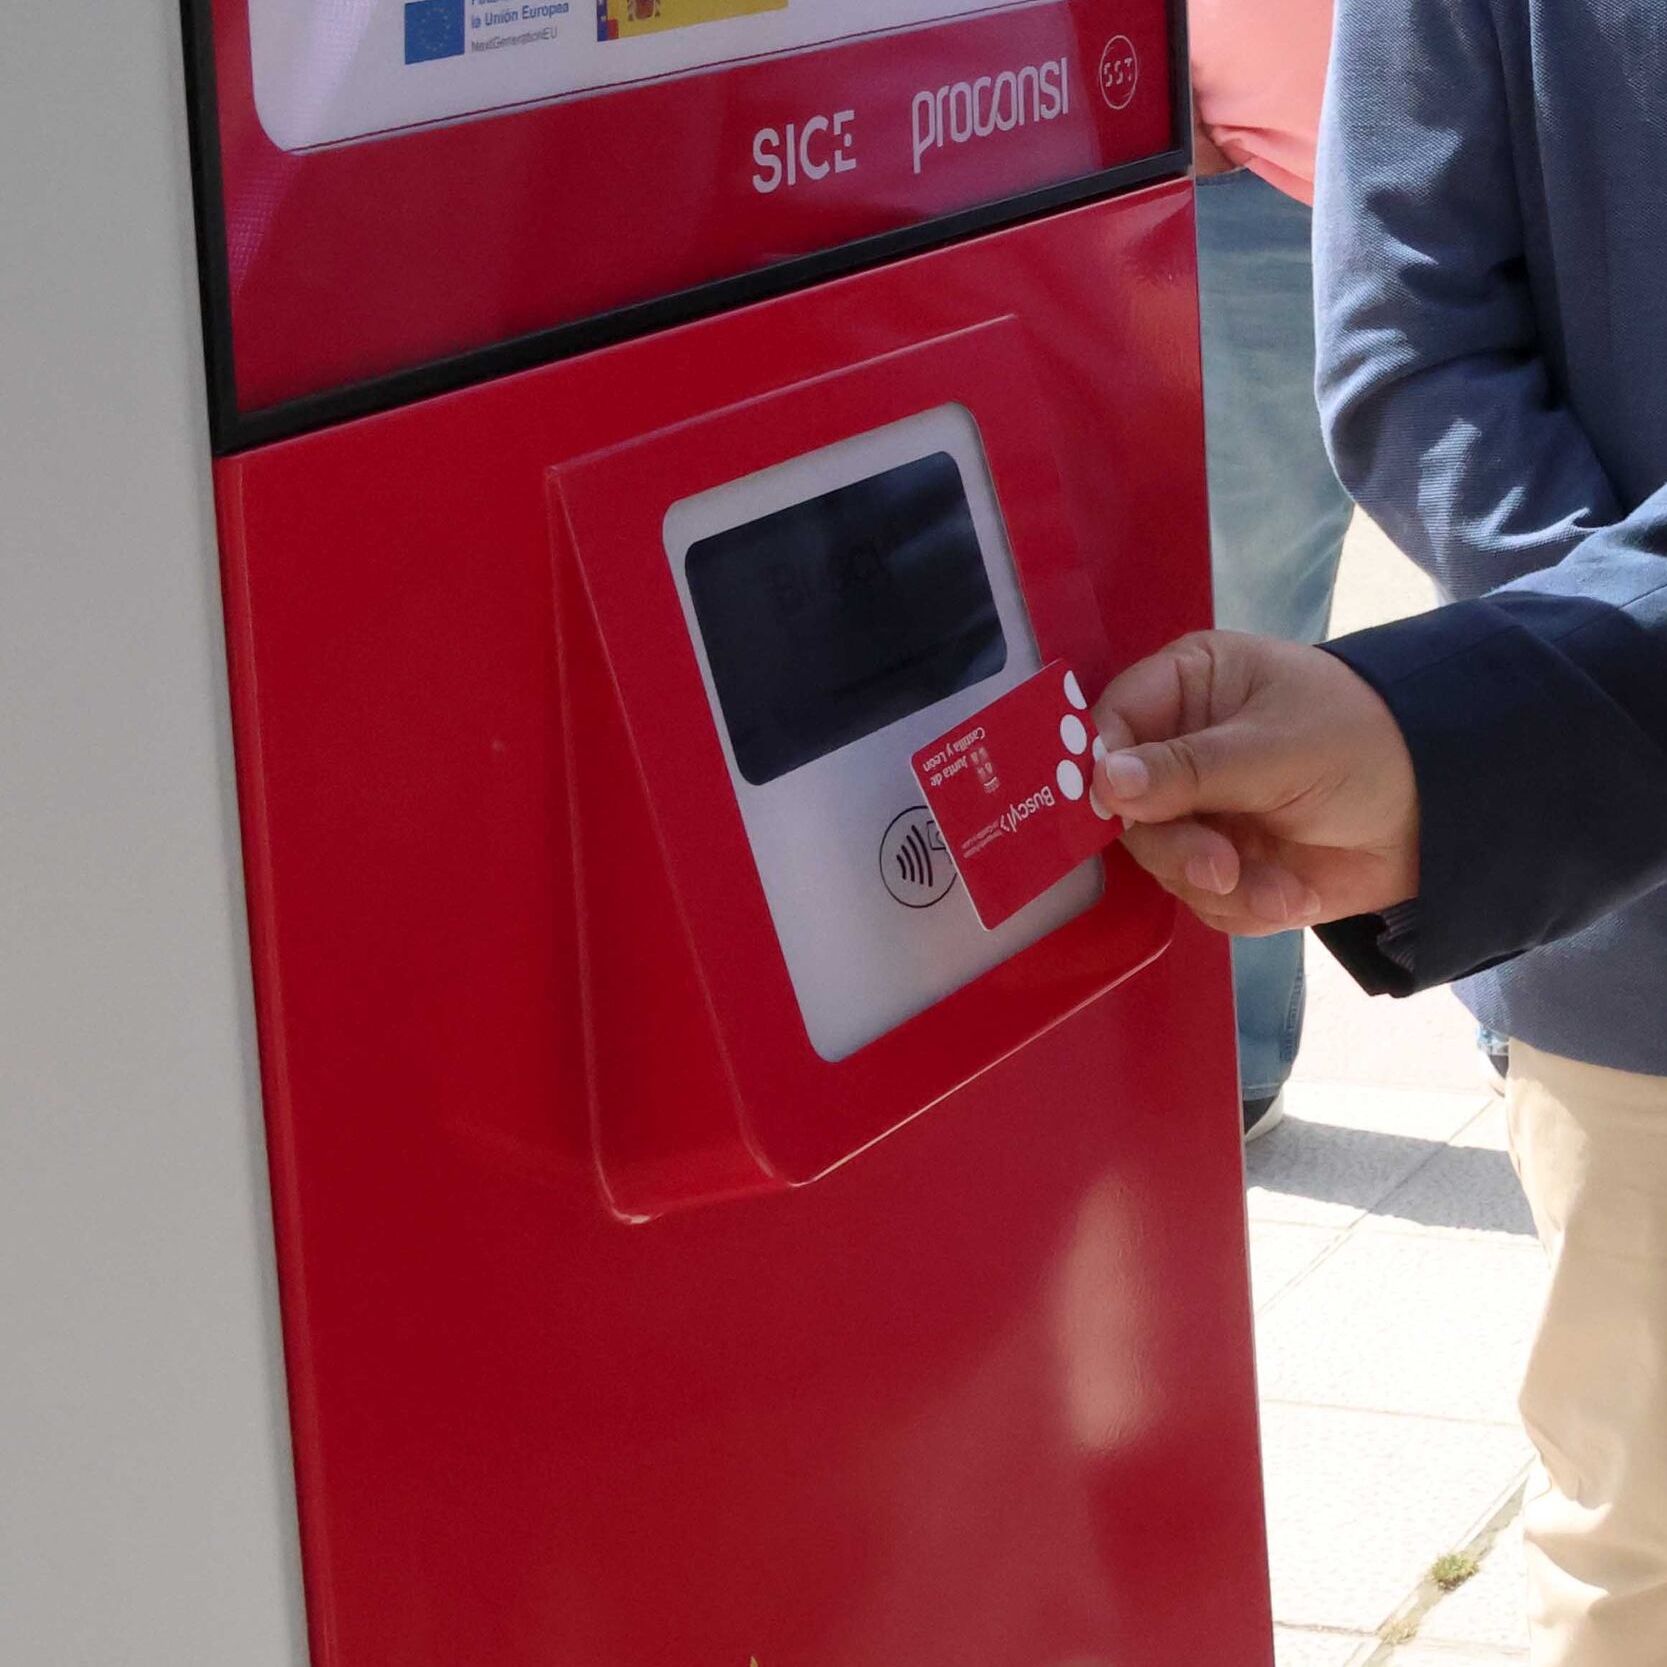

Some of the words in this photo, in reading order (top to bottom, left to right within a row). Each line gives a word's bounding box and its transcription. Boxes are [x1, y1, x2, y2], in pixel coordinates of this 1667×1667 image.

[471, 13, 481, 30] la
[484, 6, 519, 28] Unión
[521, 1, 569, 22] Europea
[471, 27, 558, 52] NextGenerationEU
[1103, 57, 1133, 88] SST
[752, 108, 857, 194] SICE
[954, 727, 986, 753] Castilla
[923, 751, 947, 772] León
[943, 755, 969, 778] Junta
[930, 771, 943, 787] de
